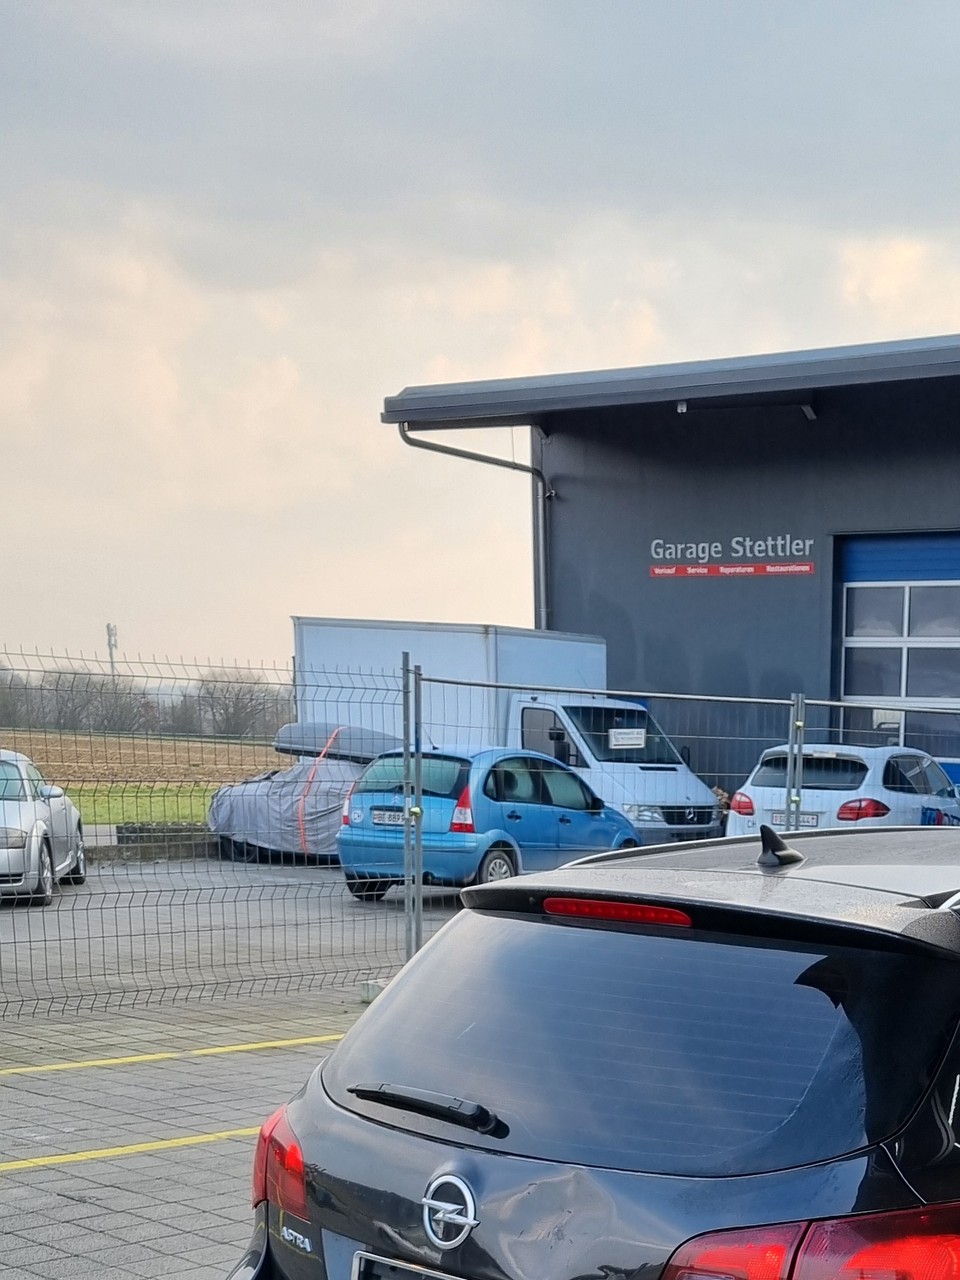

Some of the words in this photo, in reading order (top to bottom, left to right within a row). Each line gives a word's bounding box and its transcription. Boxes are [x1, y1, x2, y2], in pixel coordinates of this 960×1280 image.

[650, 539, 722, 563] Garage
[731, 534, 814, 557] Stettler
[281, 1226, 312, 1252] ASTRA
